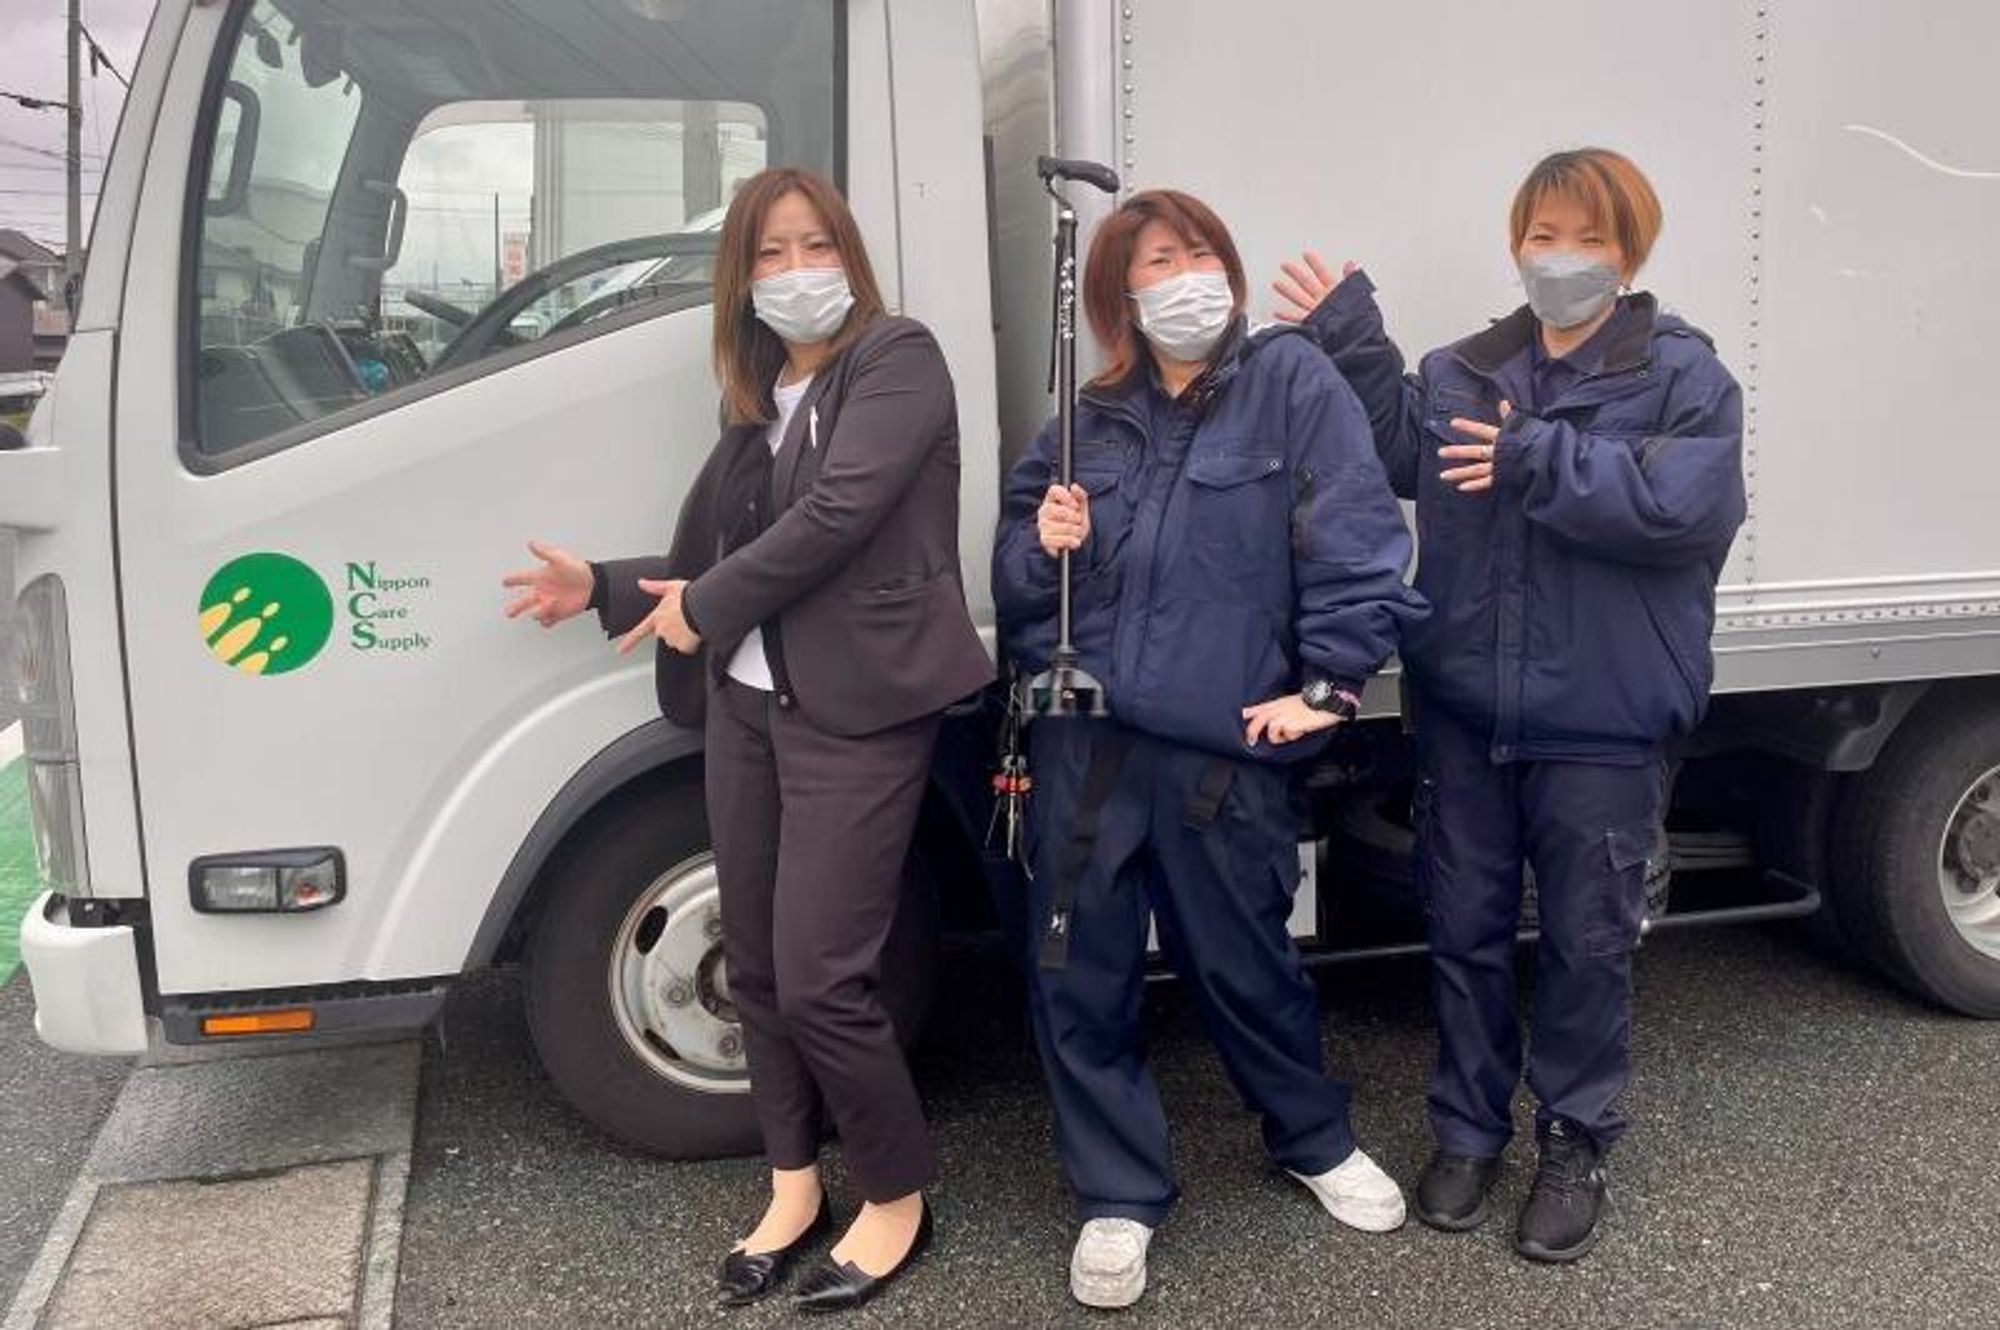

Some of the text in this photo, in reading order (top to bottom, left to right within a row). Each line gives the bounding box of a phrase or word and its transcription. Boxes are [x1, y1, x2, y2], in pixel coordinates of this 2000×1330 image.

[346, 561, 430, 591] Nippon
[348, 592, 408, 619] Care
[352, 621, 432, 651] Supply
